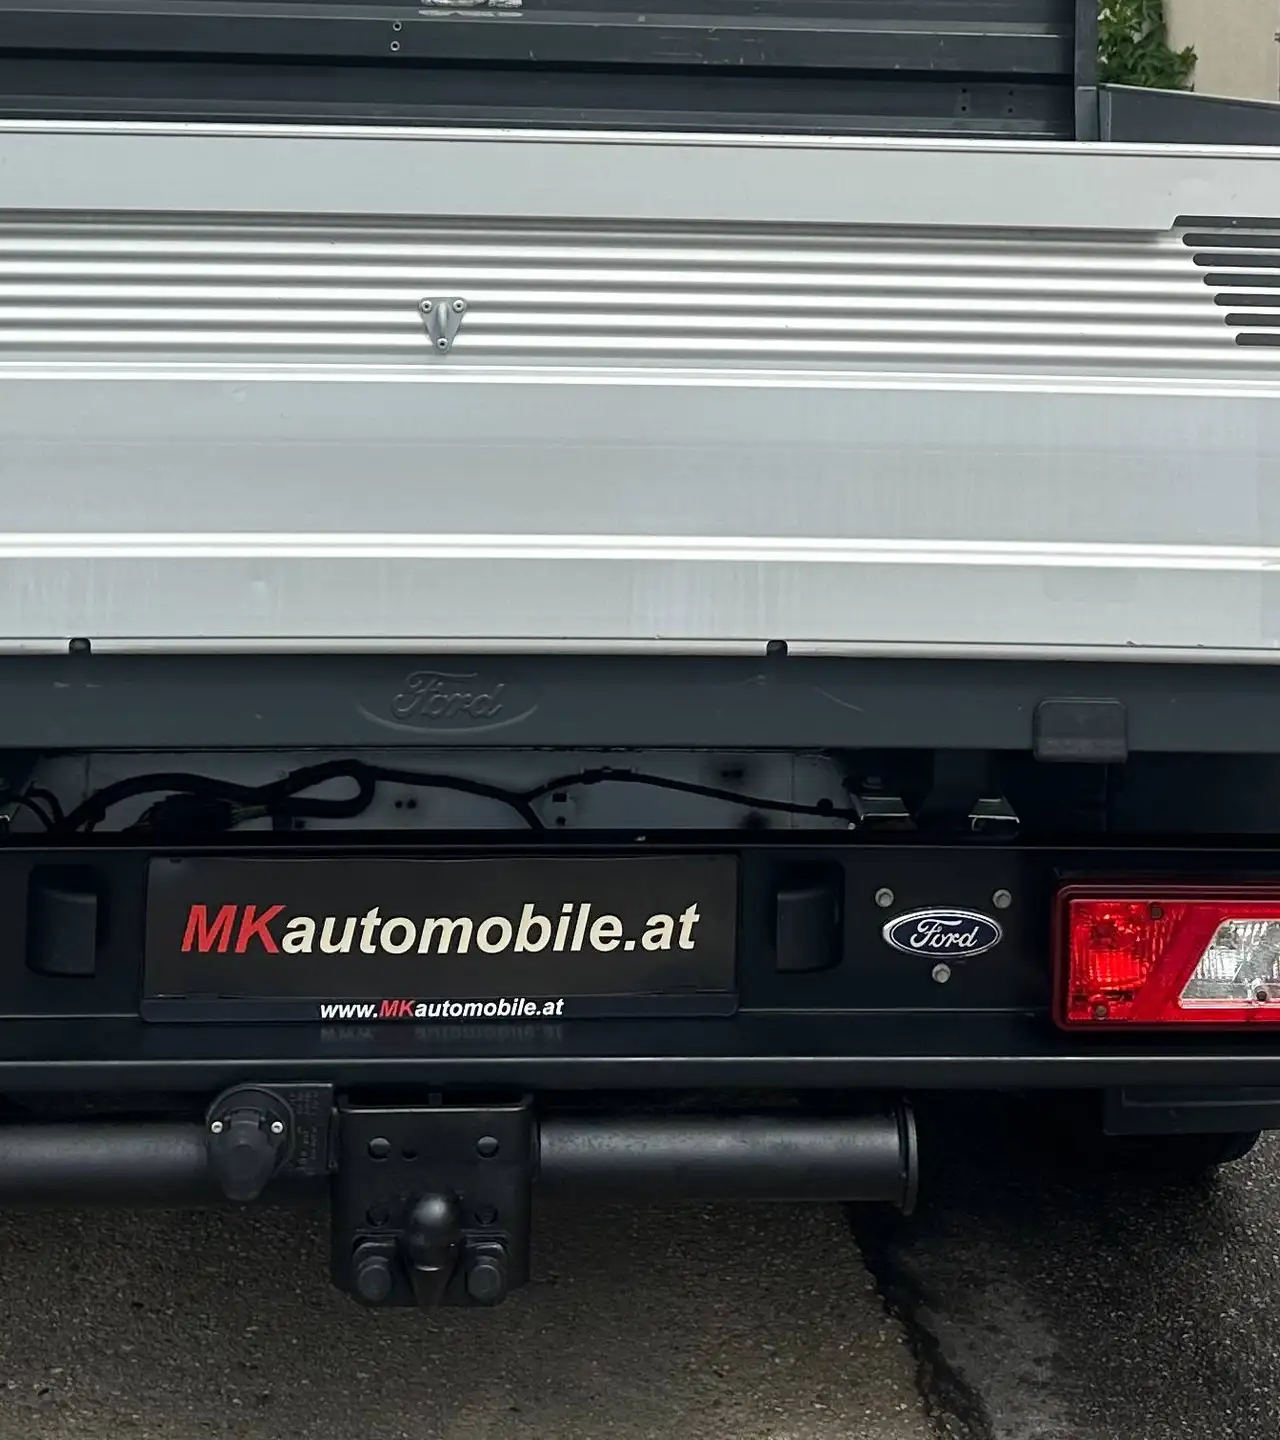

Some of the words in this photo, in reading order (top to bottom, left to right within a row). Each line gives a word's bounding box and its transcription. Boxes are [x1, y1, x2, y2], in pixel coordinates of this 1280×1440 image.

[390, 670, 506, 719] Ford
[181, 903, 700, 955] MKautomobile.at
[910, 919, 979, 948] Ford
[320, 997, 564, 1019] www.MKautomobile.at
